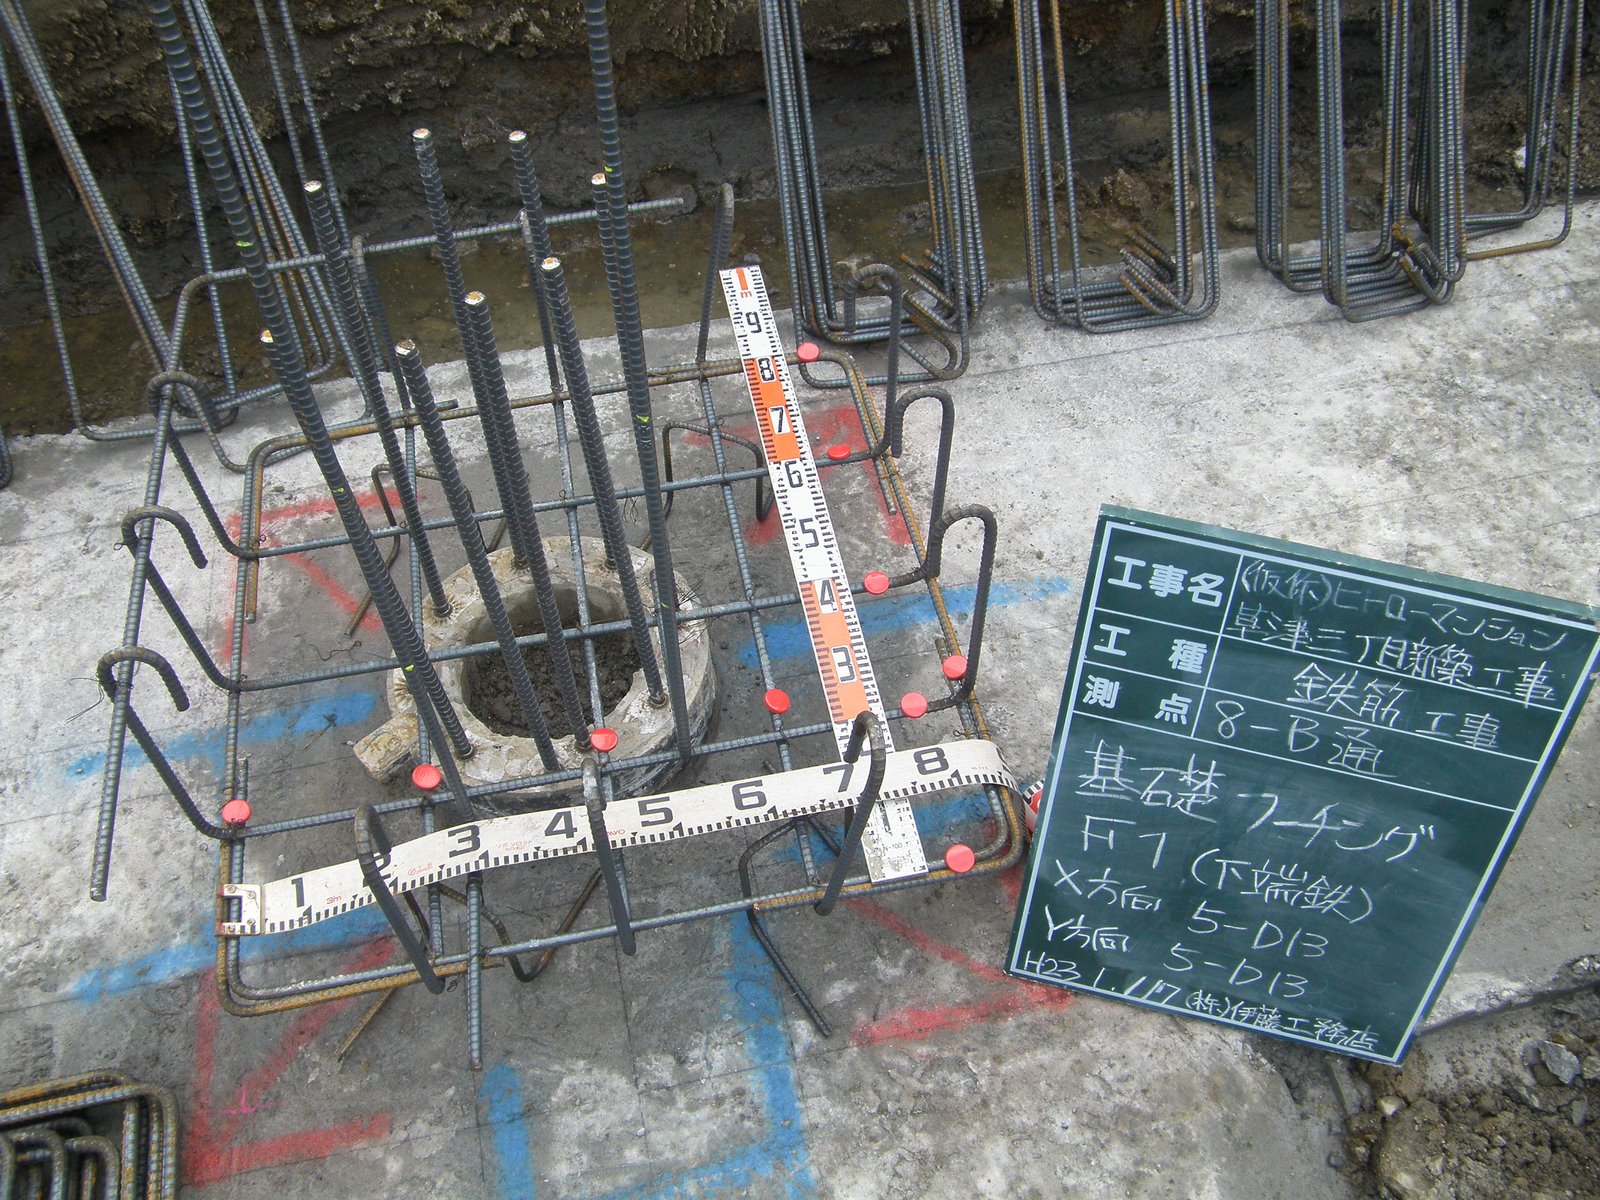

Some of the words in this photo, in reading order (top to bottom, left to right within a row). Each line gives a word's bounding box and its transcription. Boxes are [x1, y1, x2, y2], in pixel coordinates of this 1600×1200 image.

[745, 312, 762, 333] 9
[758, 357, 775, 382] 8
[769, 407, 785, 432] 7
[784, 460, 803, 488] 6
[799, 518, 820, 549] 5
[820, 580, 835, 609] 4
[832, 648, 856, 682] 3
[1108, 555, 1225, 607] 工事名
[291, 877, 304, 908] 1
[448, 824, 480, 858] 3
[544, 811, 578, 838] 4
[639, 796, 673, 828] 5
[732, 780, 766, 810] 6
[823, 763, 854, 792] 7
[914, 748, 948, 776] 8
[1188, 901, 1328, 958] 5-D13
[1164, 943, 1308, 998] 5-D13
